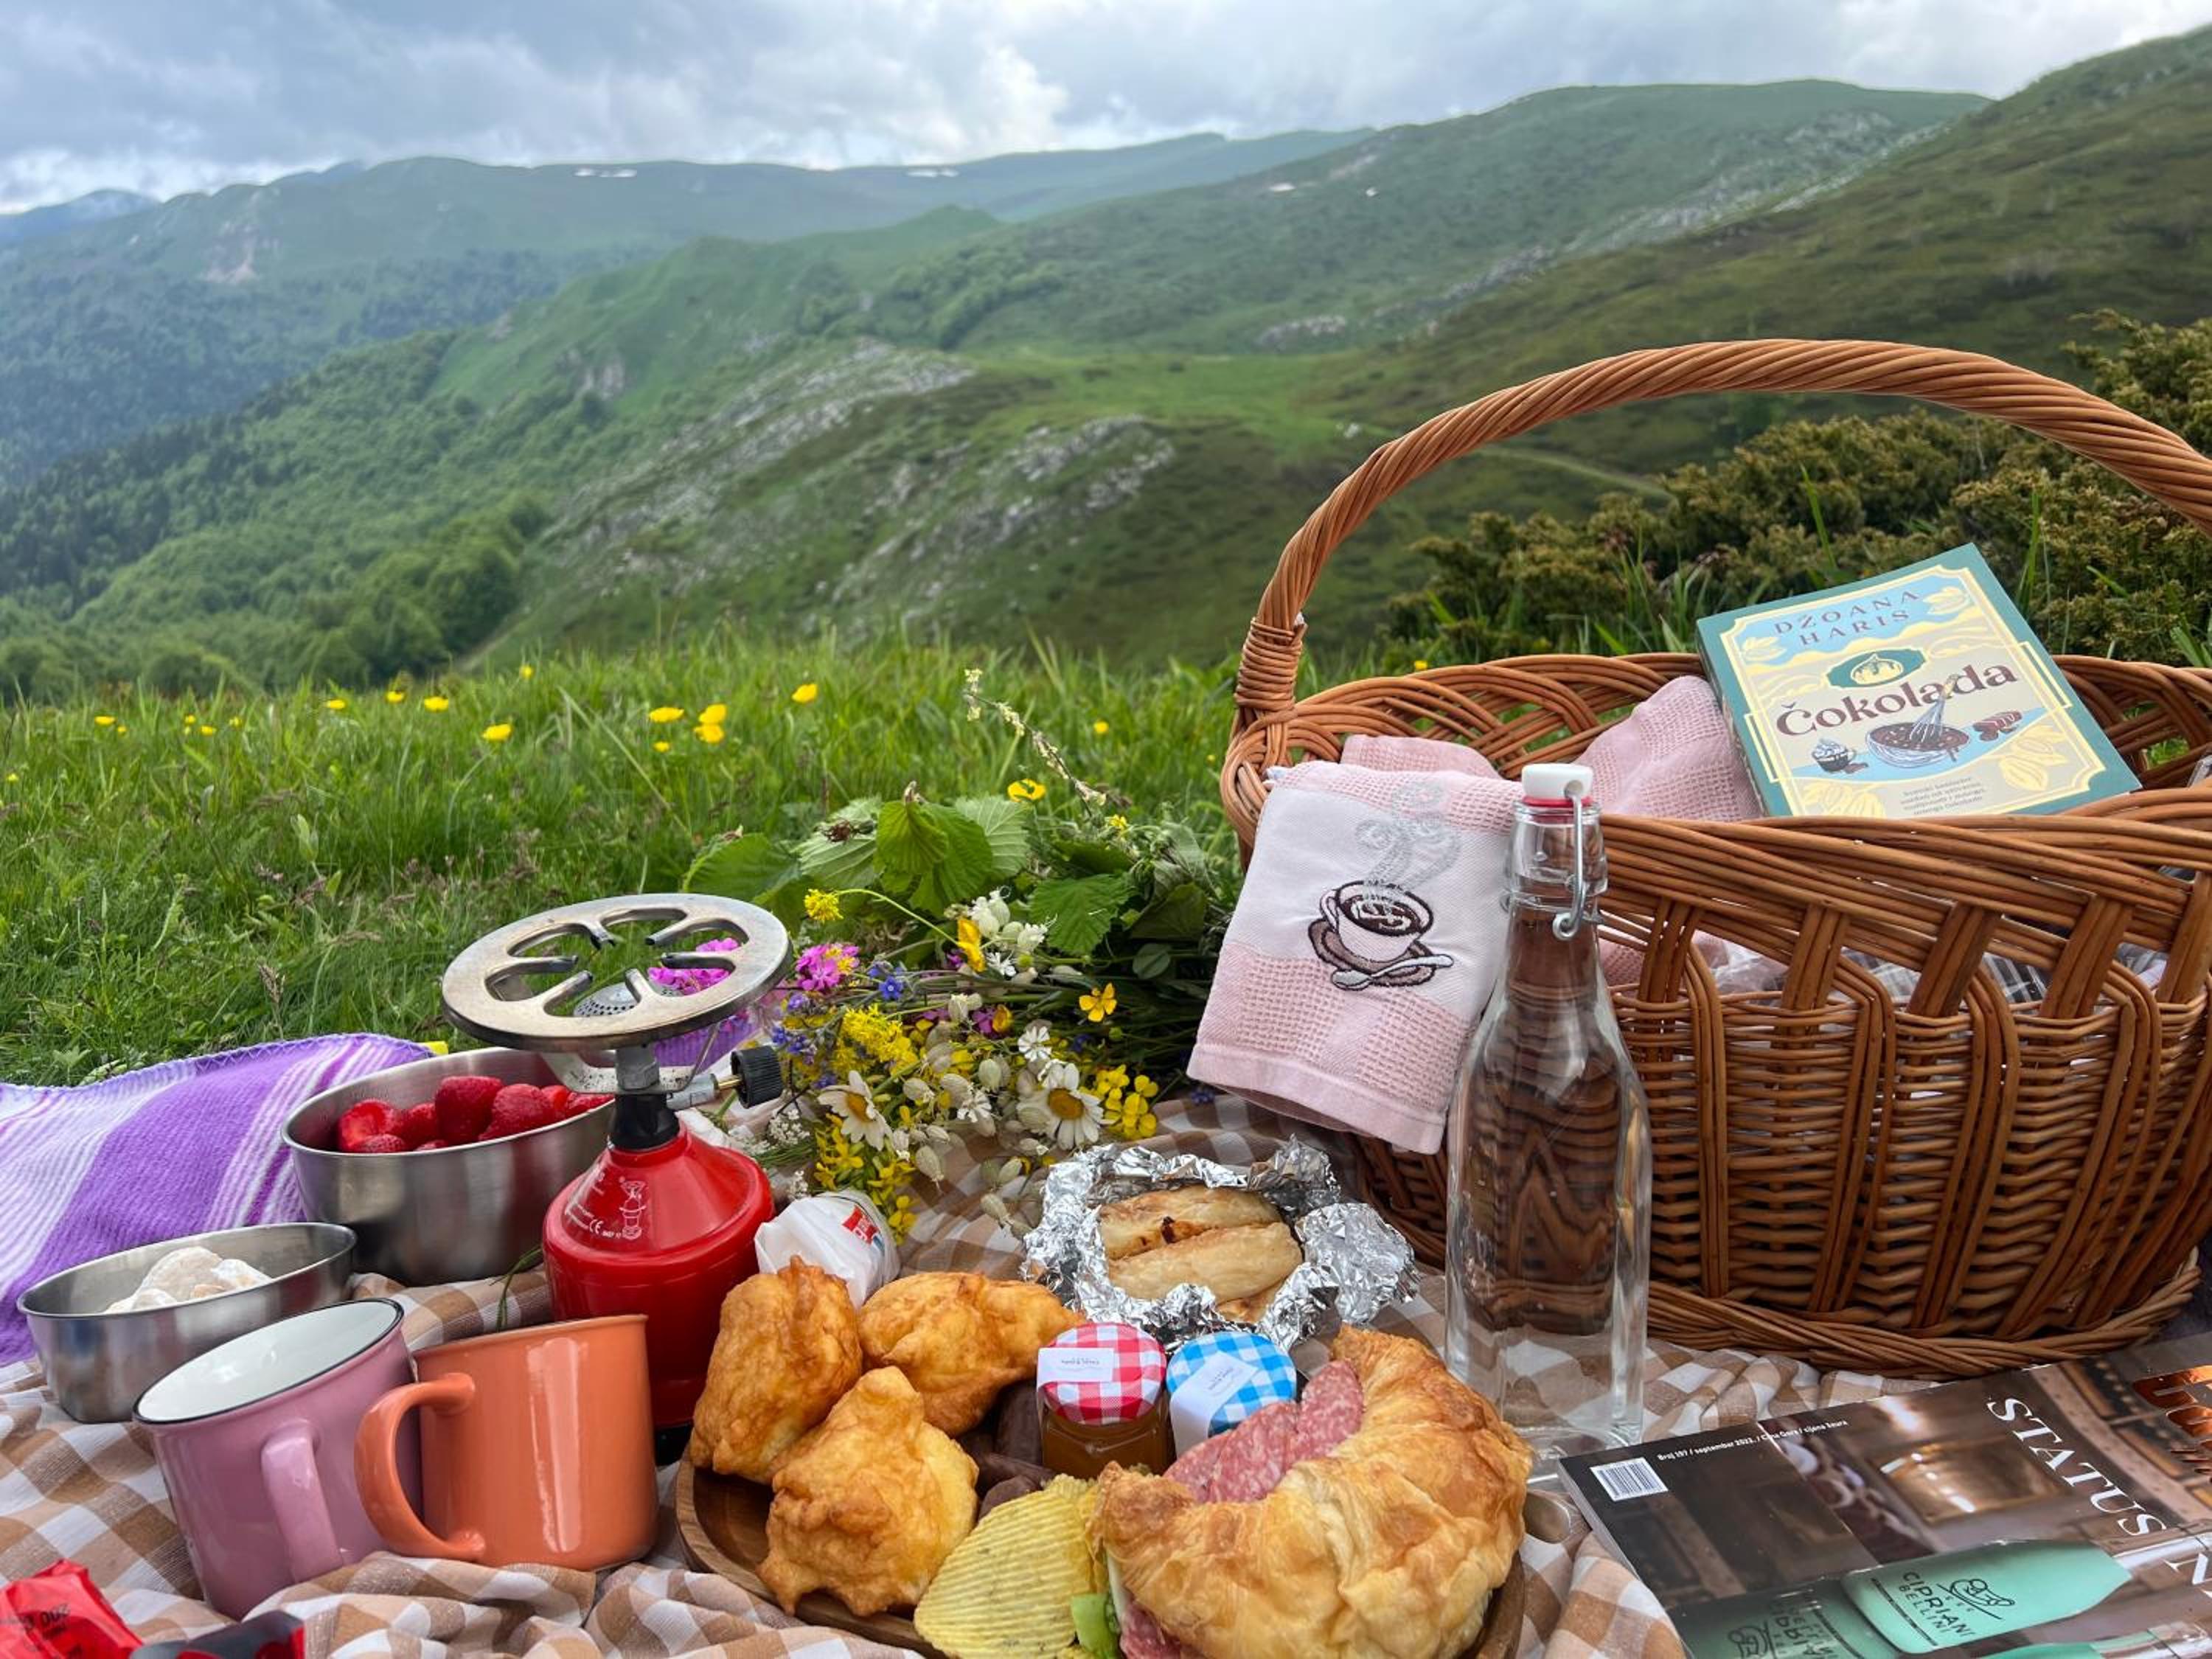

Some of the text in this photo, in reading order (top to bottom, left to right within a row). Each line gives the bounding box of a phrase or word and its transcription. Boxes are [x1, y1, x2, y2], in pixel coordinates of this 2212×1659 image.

[1799, 610, 1910, 646] HARIS
[1776, 664, 2018, 736] Čokolada
[1986, 1397, 2167, 1537] STATUS
[1899, 1585, 1951, 1633] BELLINI
[1902, 1571, 1976, 1637] CIPRIANI
